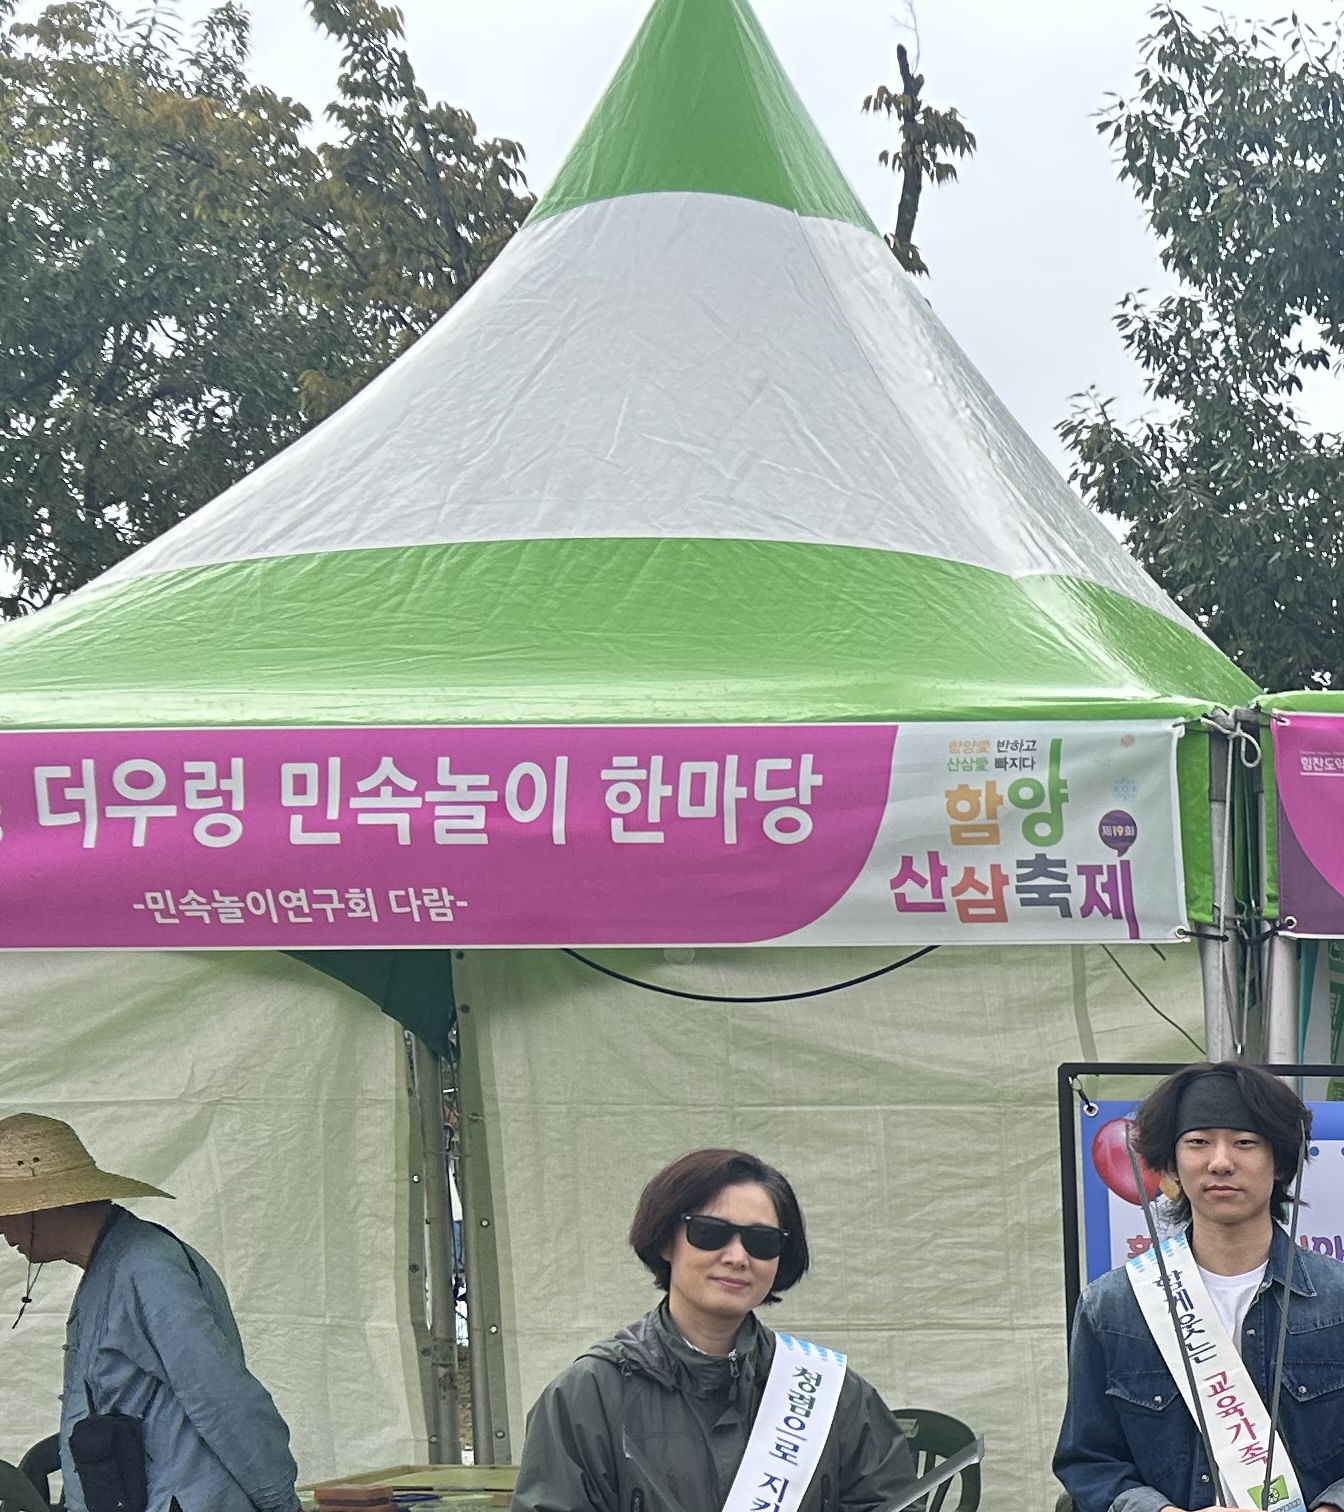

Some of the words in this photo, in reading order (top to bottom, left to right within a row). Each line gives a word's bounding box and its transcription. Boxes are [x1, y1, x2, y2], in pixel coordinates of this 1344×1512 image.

[994, 756, 1036, 771] 빠지다
[996, 739, 1037, 753] 반하고
[35, 755, 243, 850] 더우렁
[279, 752, 571, 848] 민속놀이
[598, 751, 825, 848] 한마당
[944, 738, 1069, 847] 함양
[132, 886, 380, 923] -민속놀이연구회
[388, 886, 469, 924] 다람-
[890, 850, 1140, 939] 산삼축제
